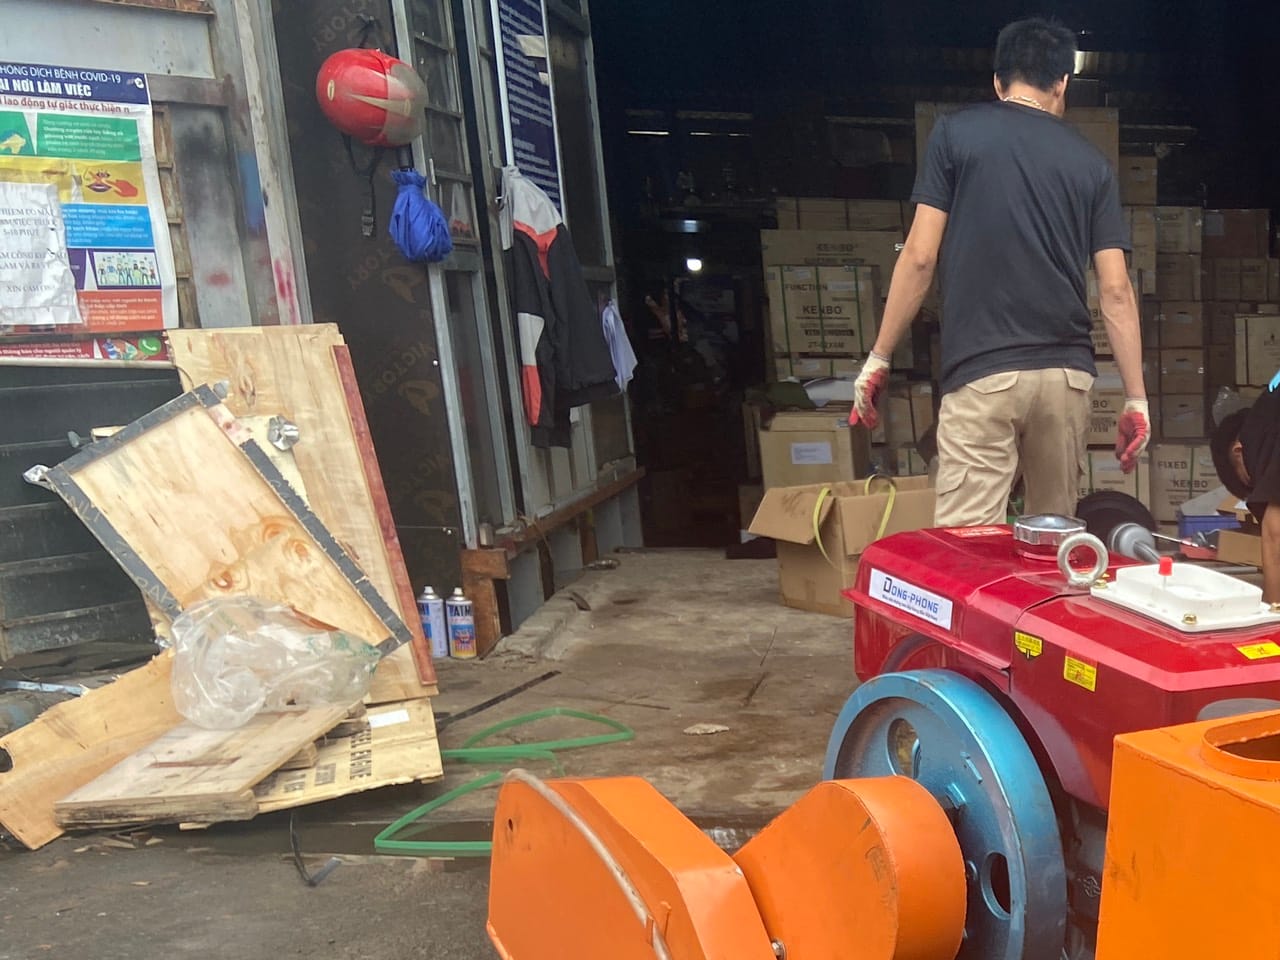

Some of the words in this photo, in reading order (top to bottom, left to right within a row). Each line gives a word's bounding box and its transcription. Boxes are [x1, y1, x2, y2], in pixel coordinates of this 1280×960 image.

[80, 71, 121, 83] COVID-19
[37, 79, 62, 94] LÀM
[64, 81, 92, 98] VIỆC
[4, 97, 19, 106] lao
[784, 283, 828, 291] FUNCTIN
[1158, 461, 1188, 469] FIXED
[1173, 480, 1208, 488] KEBO
[883, 576, 939, 614] DONG-PHONG
[350, 749, 372, 780] ENGINE
